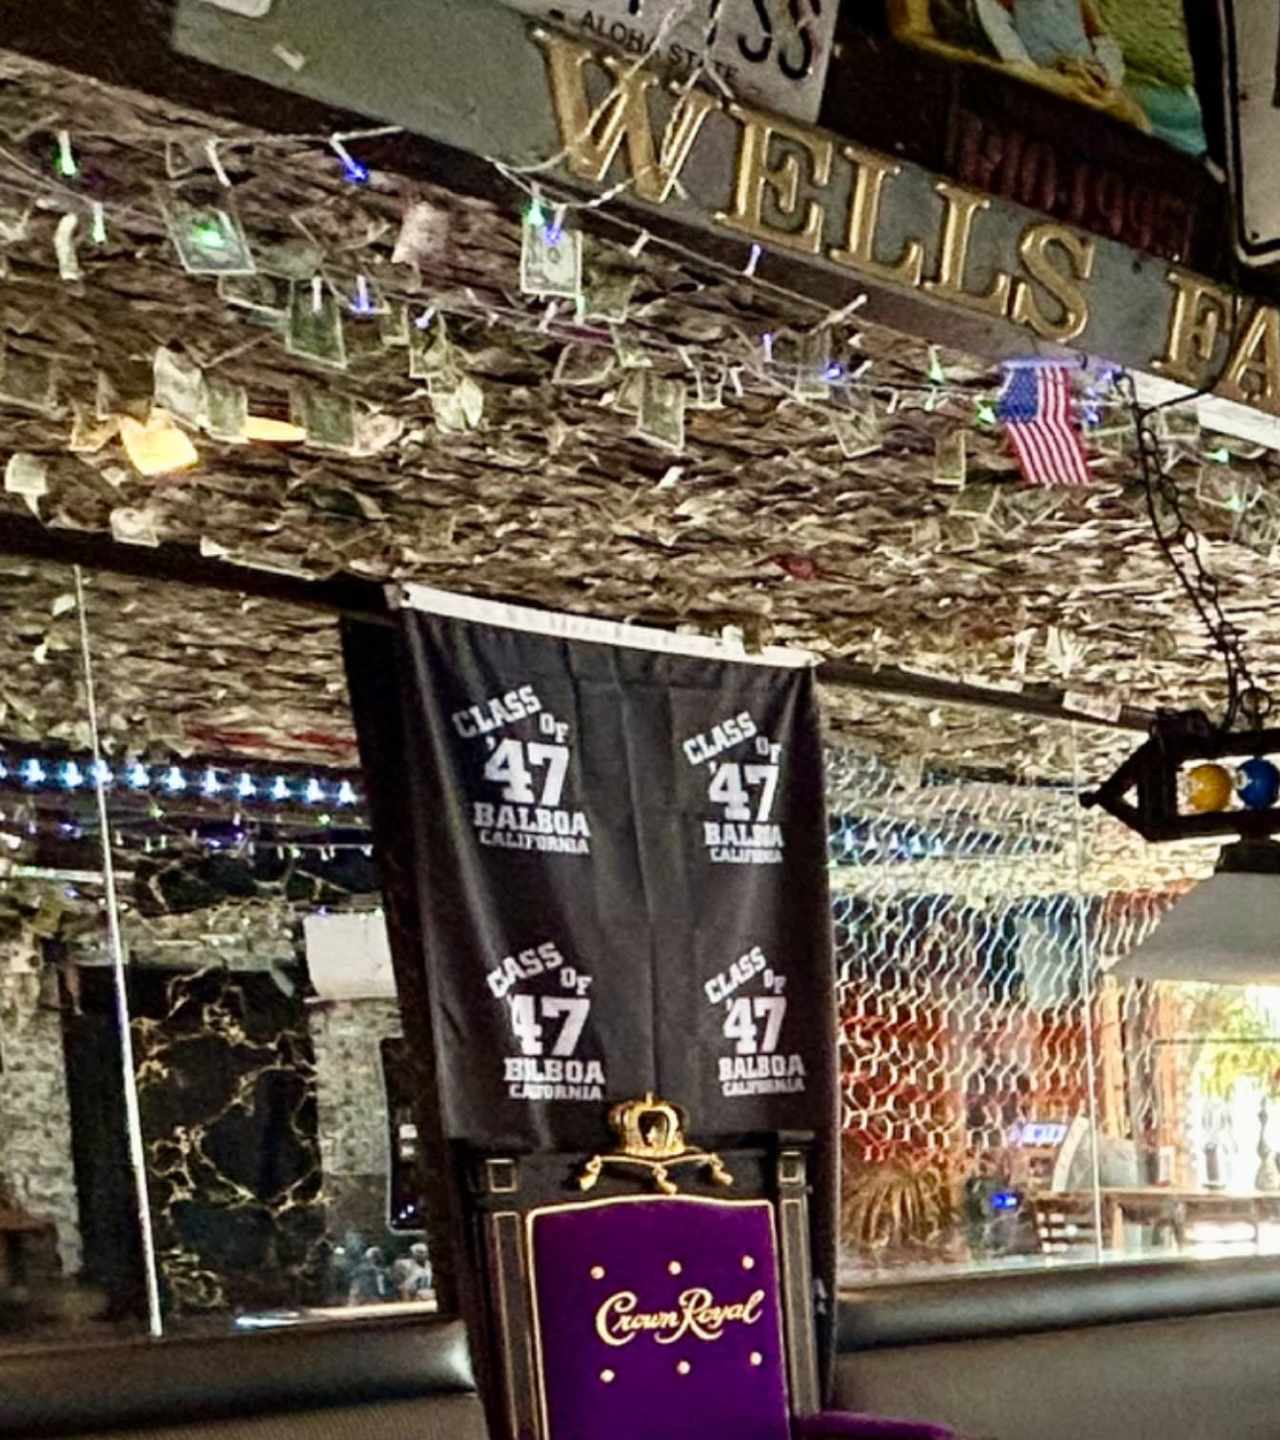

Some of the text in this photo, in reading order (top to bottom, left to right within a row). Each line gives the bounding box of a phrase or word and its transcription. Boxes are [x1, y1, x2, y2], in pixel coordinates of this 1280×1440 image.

[530, 25, 1096, 343] WELLS
[452, 684, 542, 739] CLASS
[539, 711, 570, 744] OF
[682, 710, 758, 766] CLASS
[474, 802, 592, 838] BALBOA
[478, 831, 592, 855] CALIFORNIA
[560, 966, 593, 996] OF
[703, 945, 767, 1005] CLASS
[718, 1054, 807, 1082] BALBOA
[596, 1287, 766, 1346] Crown Royal
